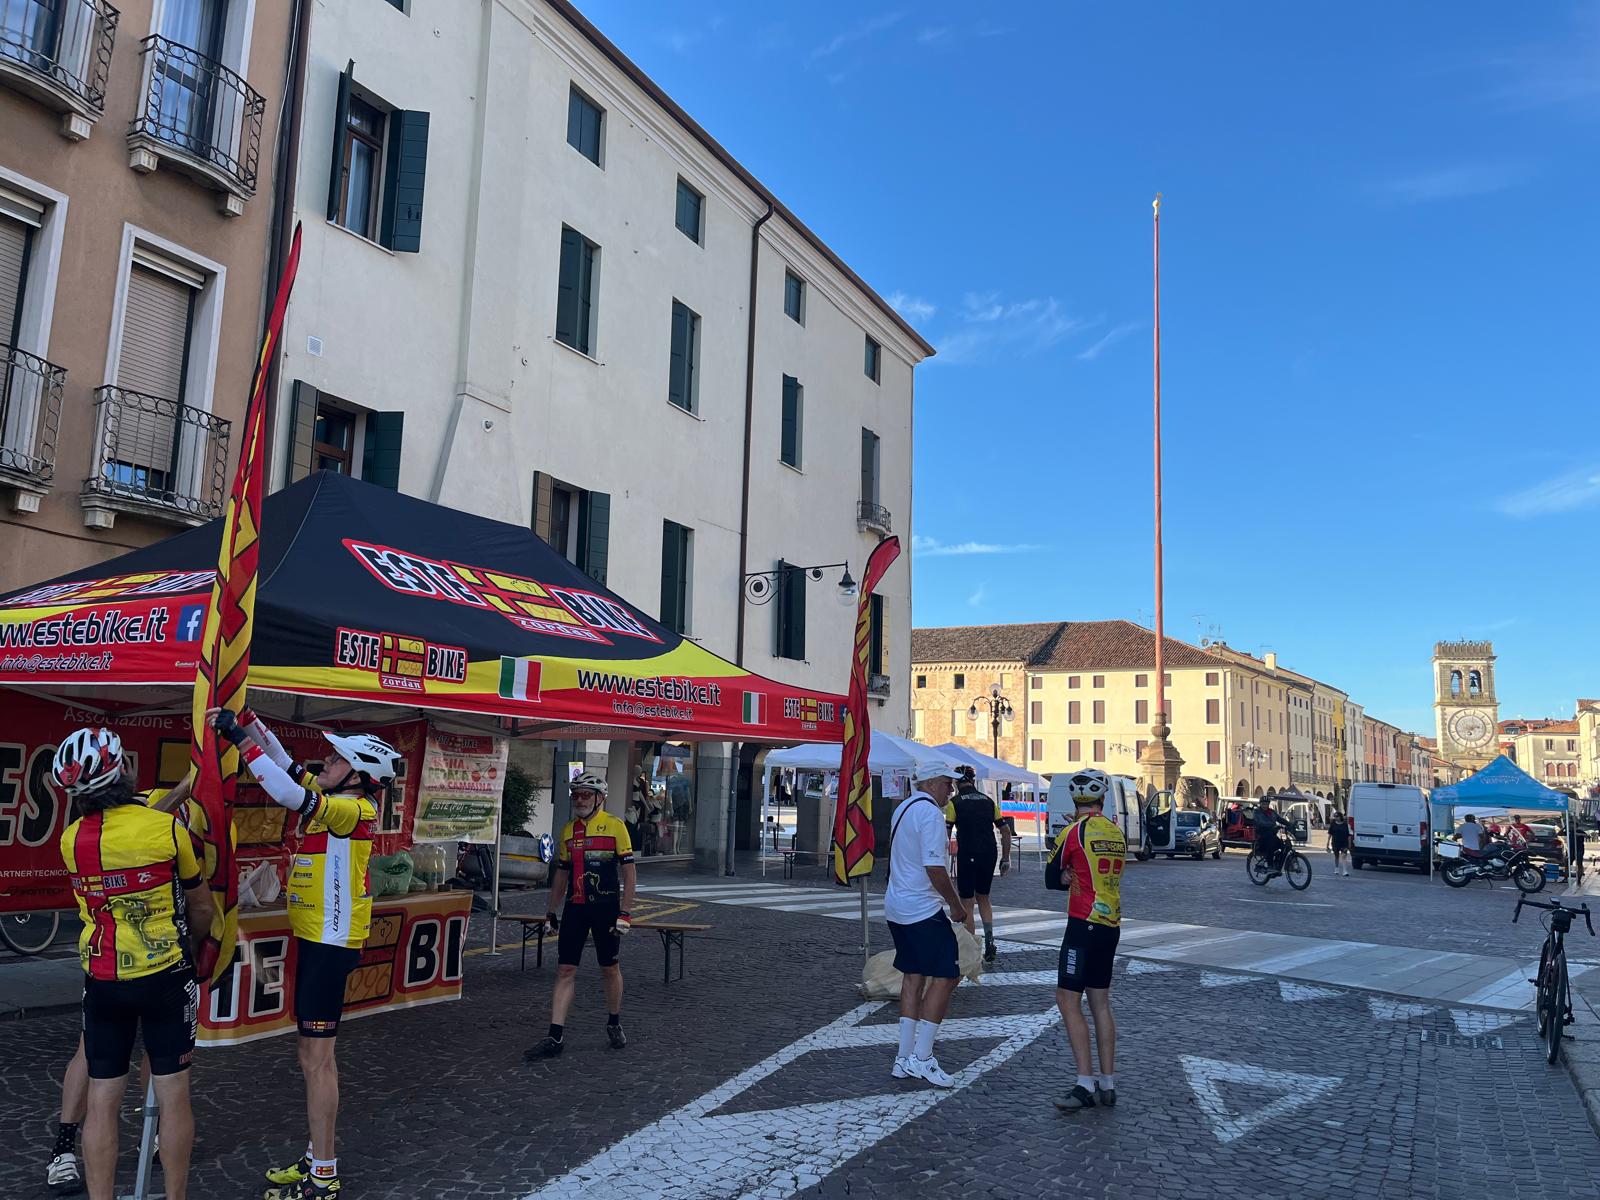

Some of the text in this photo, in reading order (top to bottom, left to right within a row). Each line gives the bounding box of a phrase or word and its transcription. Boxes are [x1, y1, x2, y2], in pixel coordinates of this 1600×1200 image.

[352, 544, 657, 640] ESTE BIKE
[0, 607, 169, 648] ww.estebike.it
[0, 651, 113, 673] info@estebike.it
[338, 630, 465, 681] ESTE BIKE
[382, 676, 421, 689] zordan
[577, 669, 721, 707] www.estebike.it
[612, 699, 694, 721] info@estebike.it
[784, 697, 835, 722] ESTE BIKE
[34, 869, 69, 877] TECNICO
[104, 873, 127, 890] BIKE
[404, 916, 469, 988] BI
